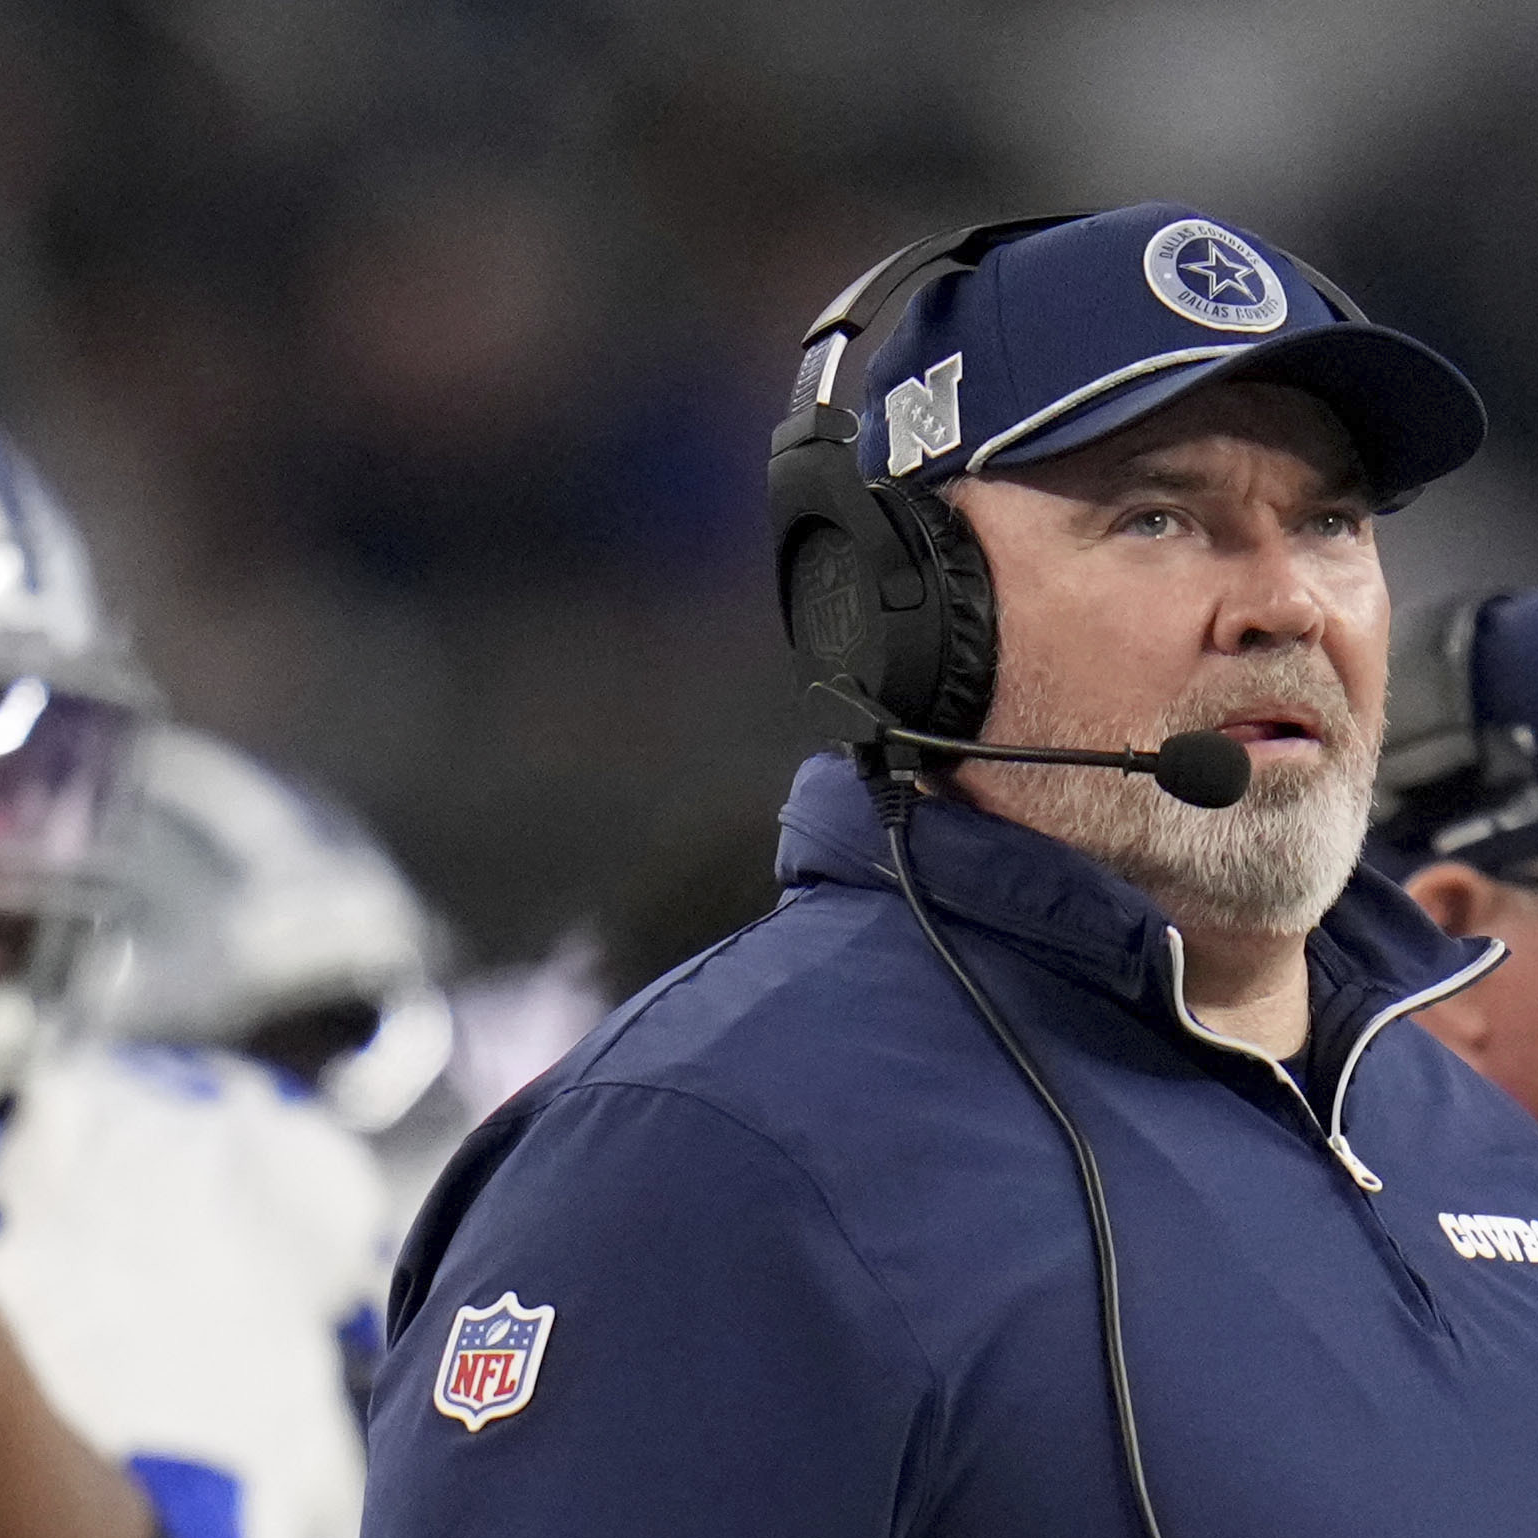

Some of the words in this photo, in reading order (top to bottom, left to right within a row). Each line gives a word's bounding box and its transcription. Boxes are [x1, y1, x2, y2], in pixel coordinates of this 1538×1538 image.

[1159, 227, 1196, 260] DALLAS
[1177, 290, 1230, 319] DALLAS
[450, 1353, 517, 1403] NFL
